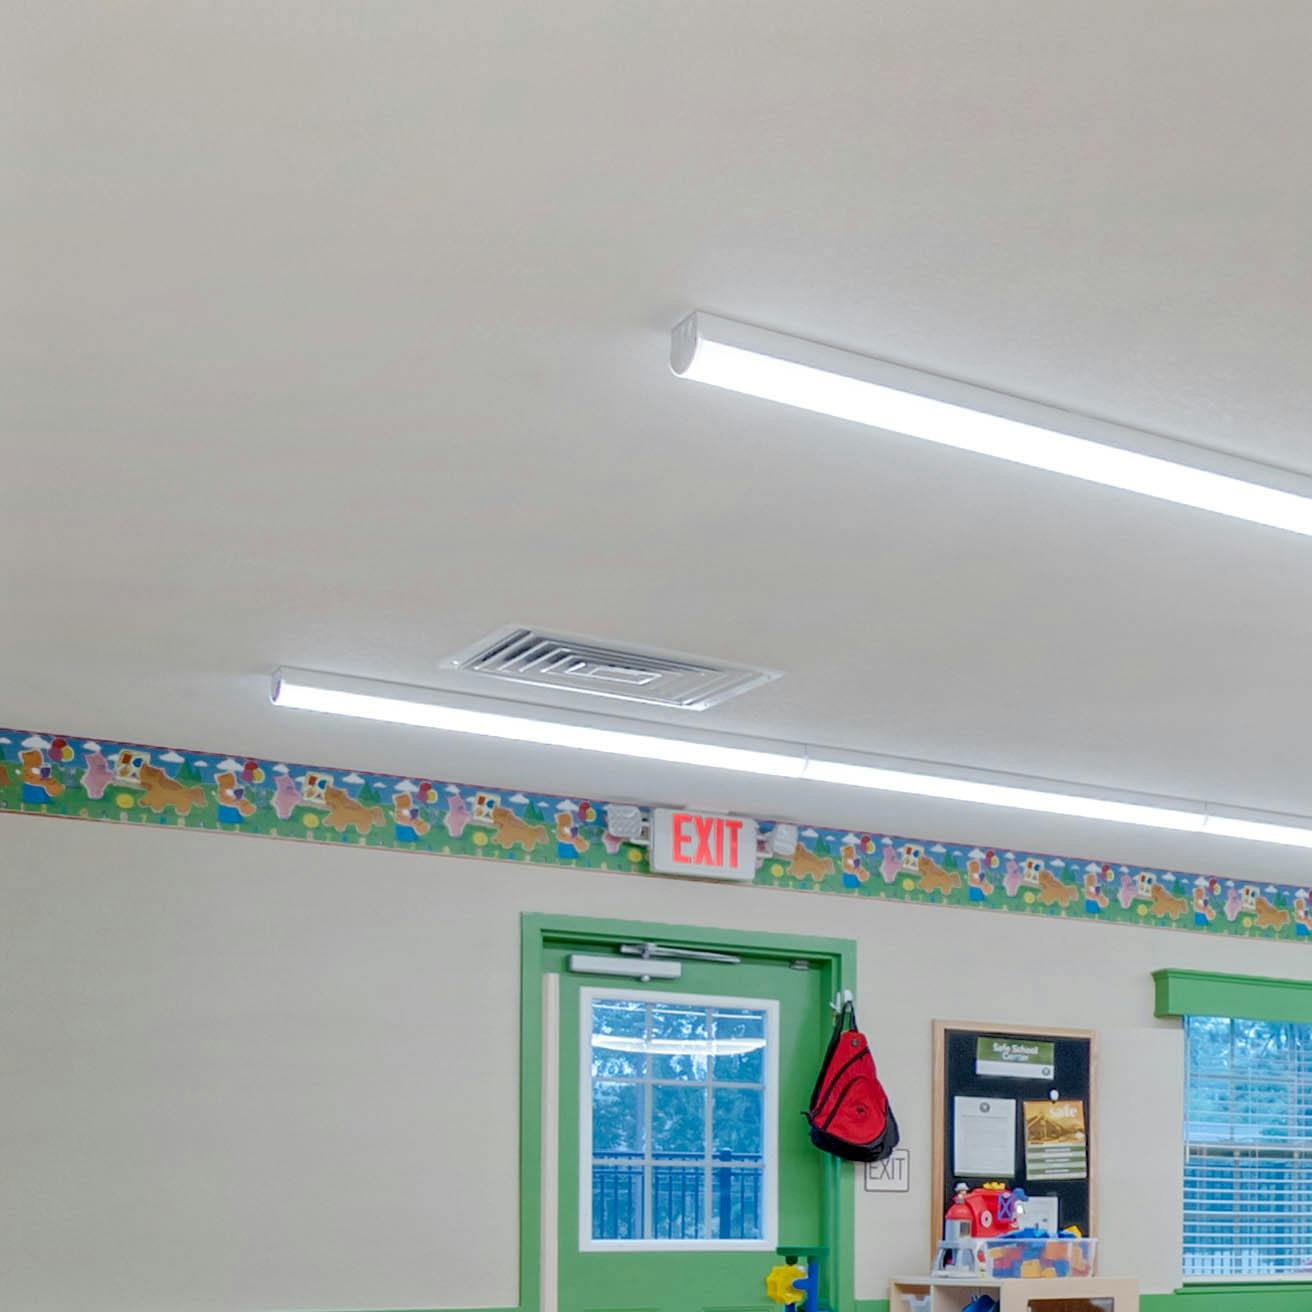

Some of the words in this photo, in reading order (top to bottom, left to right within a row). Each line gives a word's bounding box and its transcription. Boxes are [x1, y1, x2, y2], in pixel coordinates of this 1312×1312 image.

[672, 812, 743, 869] EXIT
[992, 1041, 1011, 1054] Safe
[1011, 1044, 1039, 1055] School
[1049, 1104, 1078, 1118] safe
[868, 1157, 906, 1181] EXIT
